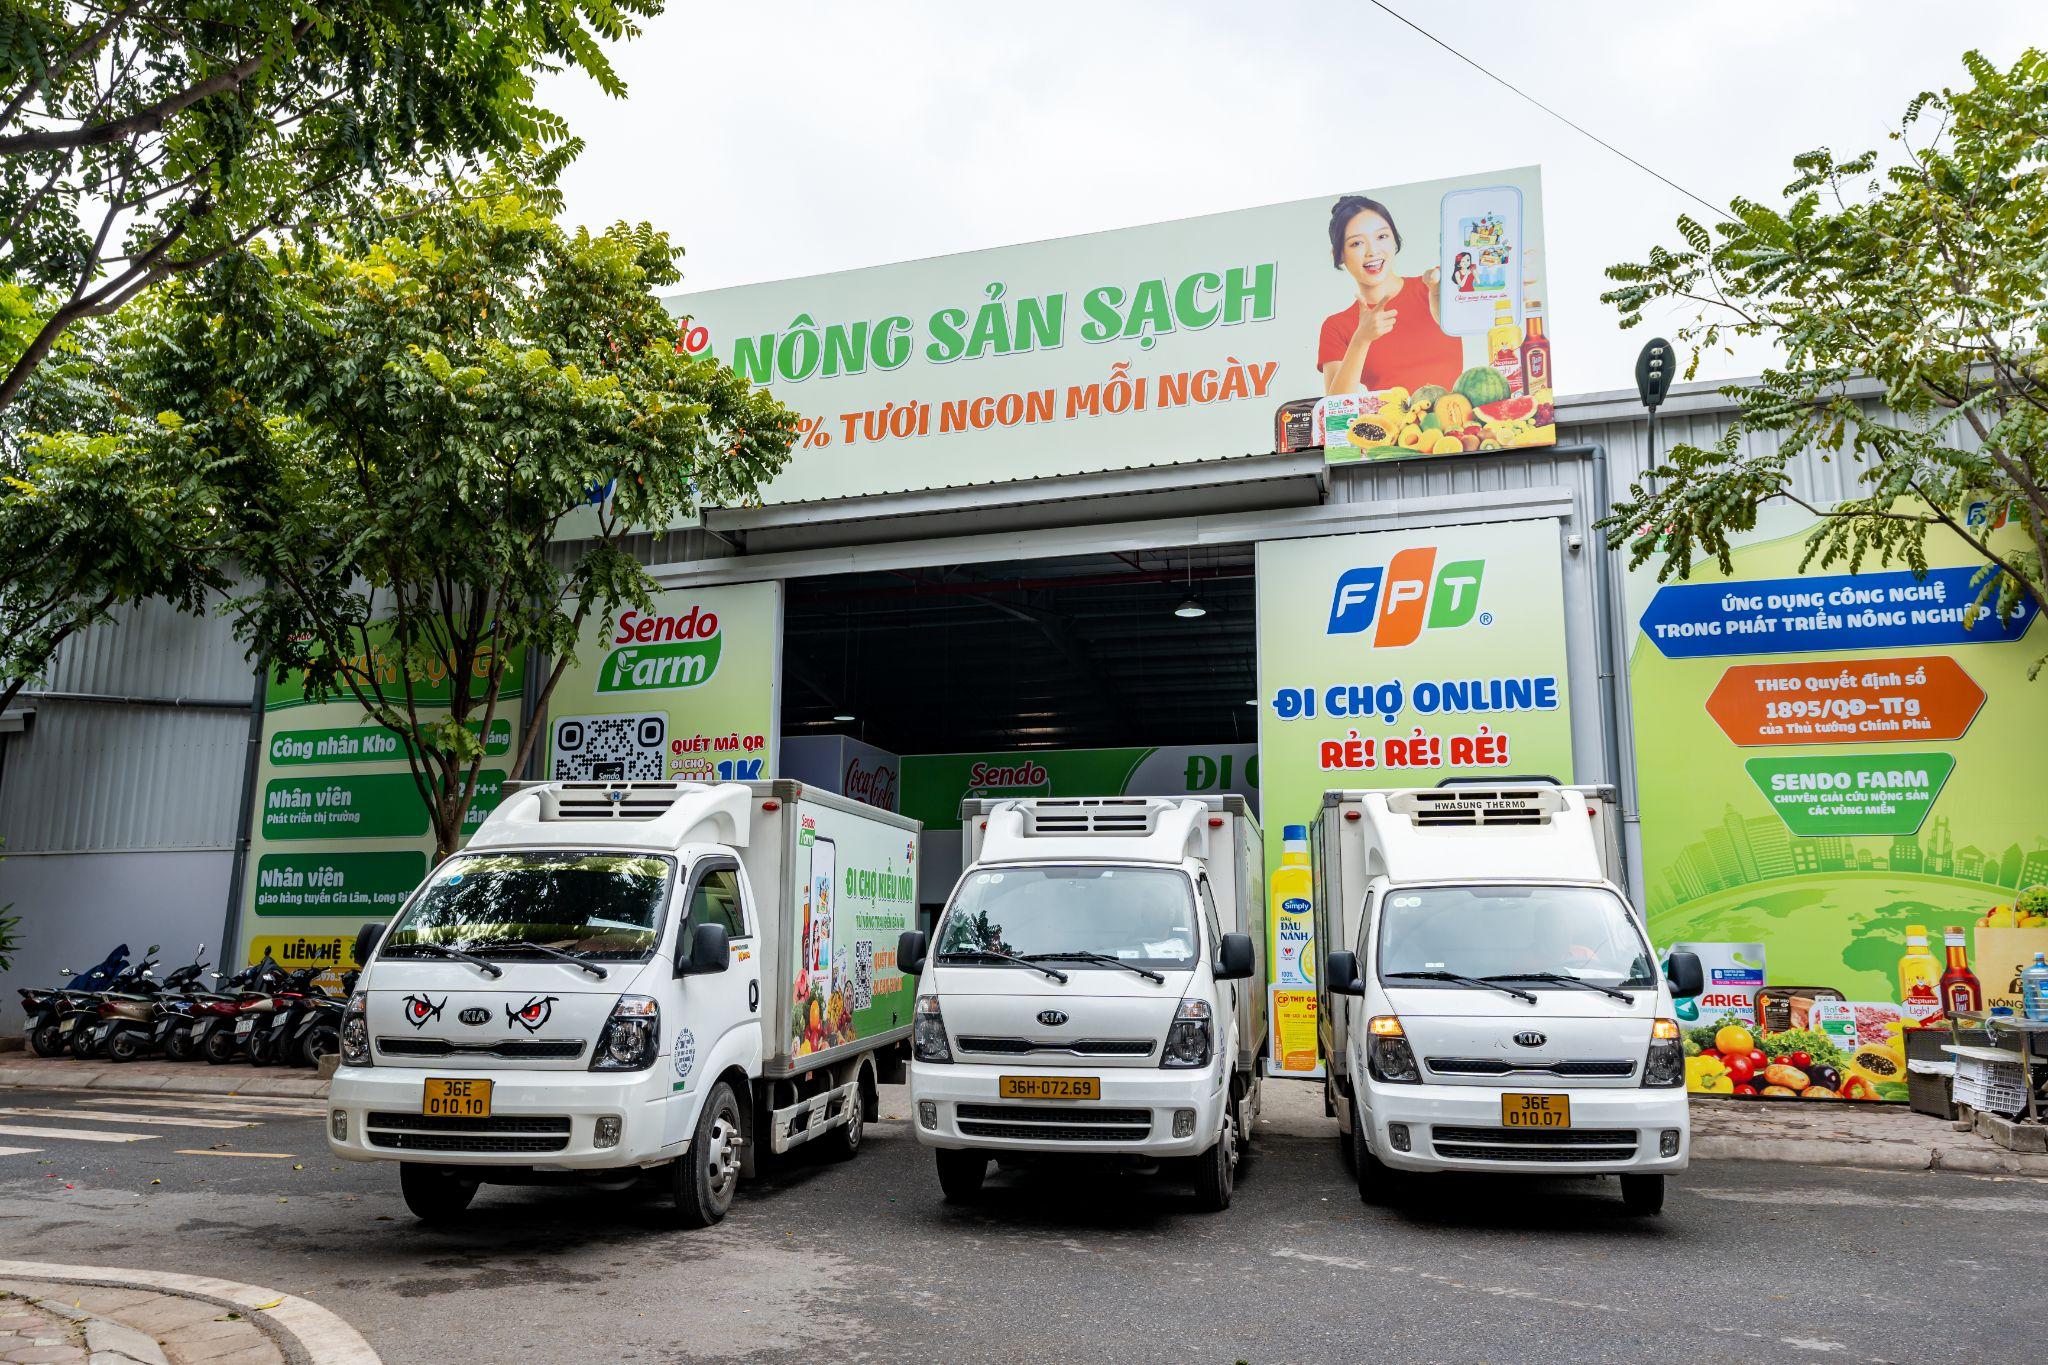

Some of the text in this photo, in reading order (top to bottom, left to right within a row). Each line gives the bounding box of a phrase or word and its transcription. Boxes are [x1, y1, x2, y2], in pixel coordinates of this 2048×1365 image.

[733, 314, 912, 385] NÔNG
[927, 282, 1065, 362] SẢN
[1082, 262, 1277, 351] SẠCH
[841, 399, 928, 445] TƯƠI
[940, 388, 1055, 434] NGON
[1066, 359, 1147, 416] MỖI
[1156, 356, 1279, 408] NGÀY
[1722, 581, 1946, 612] ỨNG DỤNG CÔNG NGHỆ
[615, 605, 718, 644] Sendo
[1655, 621, 1721, 638] TRONG
[1726, 615, 1777, 634] PHÁT
[1782, 608, 1842, 632] TRIỂN
[1847, 609, 1906, 628] NÔNG
[612, 650, 706, 687] Farm
[1755, 666, 1927, 691] THEO Quyết định số
[1273, 678, 1557, 723] ĐI CHỢ ONLINE
[1759, 717, 1931, 735] của Thủ tướng Chính Phủ
[273, 734, 397, 760] Công nhân Kho
[672, 733, 765, 755] QUÉT MÃ QR
[1321, 725, 1508, 768] RẺ! RẺ! RẺ!
[671, 760, 685, 769] ĐI
[718, 759, 763, 780] 1K
[1184, 754, 1233, 792] ĐI
[969, 761, 1047, 787] Sendo
[1771, 770, 1929, 790] SENDO FARM
[268, 786, 352, 808] Nhân viên
[1774, 792, 1818, 803] CHUYÊN
[1846, 790, 1868, 802] CỨU
[1871, 790, 1902, 801] NÔNG
[1906, 789, 1929, 800] SẢN
[1435, 800, 1526, 810] HWASUNG THERMO
[1808, 801, 1895, 815] CÁC VÙNG MIỀN
[266, 808, 360, 825] Phát triển thị trường
[801, 813, 816, 830] Sendo
[261, 866, 344, 887] Nhân viên
[258, 893, 278, 905] giao
[280, 892, 301, 905] hàng
[304, 888, 330, 905] tuyến
[333, 893, 347, 903] Gia
[350, 891, 371, 905] Lâm,
[374, 893, 396, 905] Long
[1284, 900, 1309, 911] Simply
[283, 938, 341, 965] LIÊN HỆ
[1277, 996, 1289, 1004] CP
[1702, 994, 1753, 1007] ARIEL
[1908, 997, 1938, 1005] Neptune
[1988, 998, 2024, 1010] NÔNG
[462, 1009, 487, 1024] KIA
[1041, 1012, 1064, 1025] KIA
[1910, 1006, 1931, 1017] Light
[1518, 1032, 1543, 1045] KIA
[443, 1081, 472, 1096] 36E
[1008, 1080, 1092, 1097] 36H-072.69
[430, 1098, 483, 1114] 010.10
[1522, 1097, 1549, 1110] 36E
[1509, 1112, 1563, 1126] 010.07
